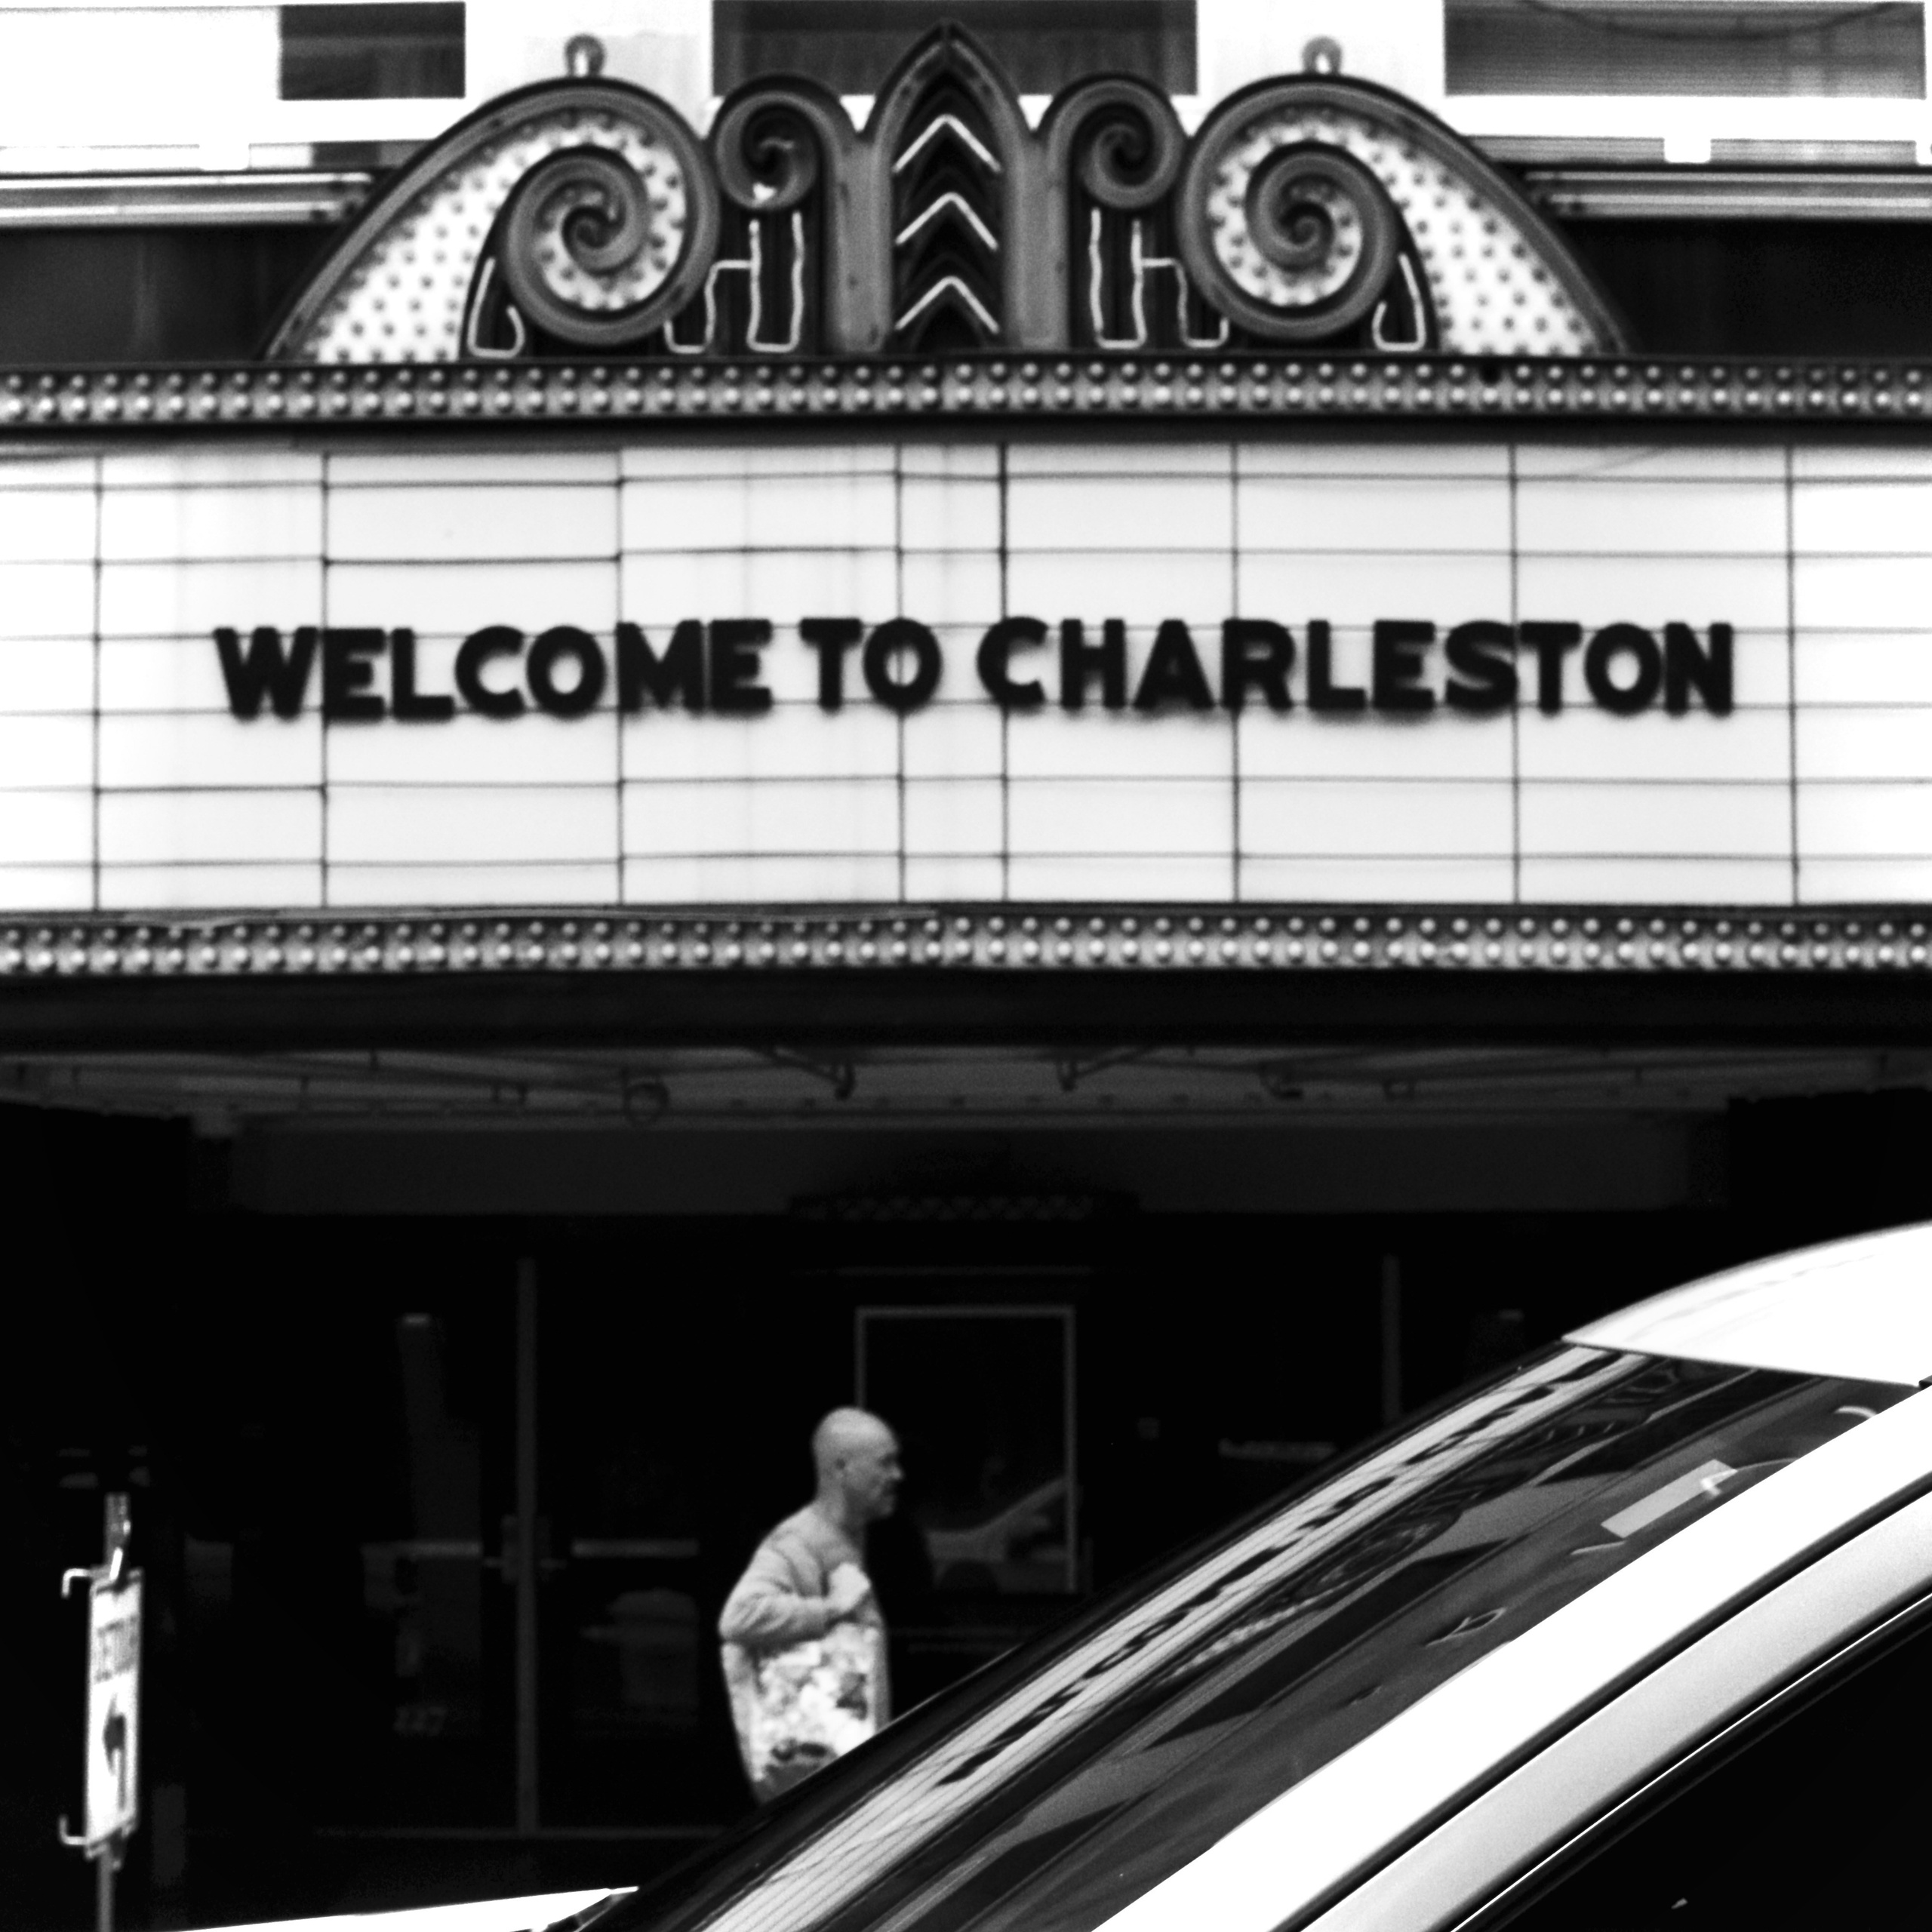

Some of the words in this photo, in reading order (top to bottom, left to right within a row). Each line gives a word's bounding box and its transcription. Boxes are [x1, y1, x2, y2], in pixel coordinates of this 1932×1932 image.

[213, 618, 773, 722] WELCOME
[798, 617, 943, 716] TO
[976, 616, 1734, 719] CHARLESTON
